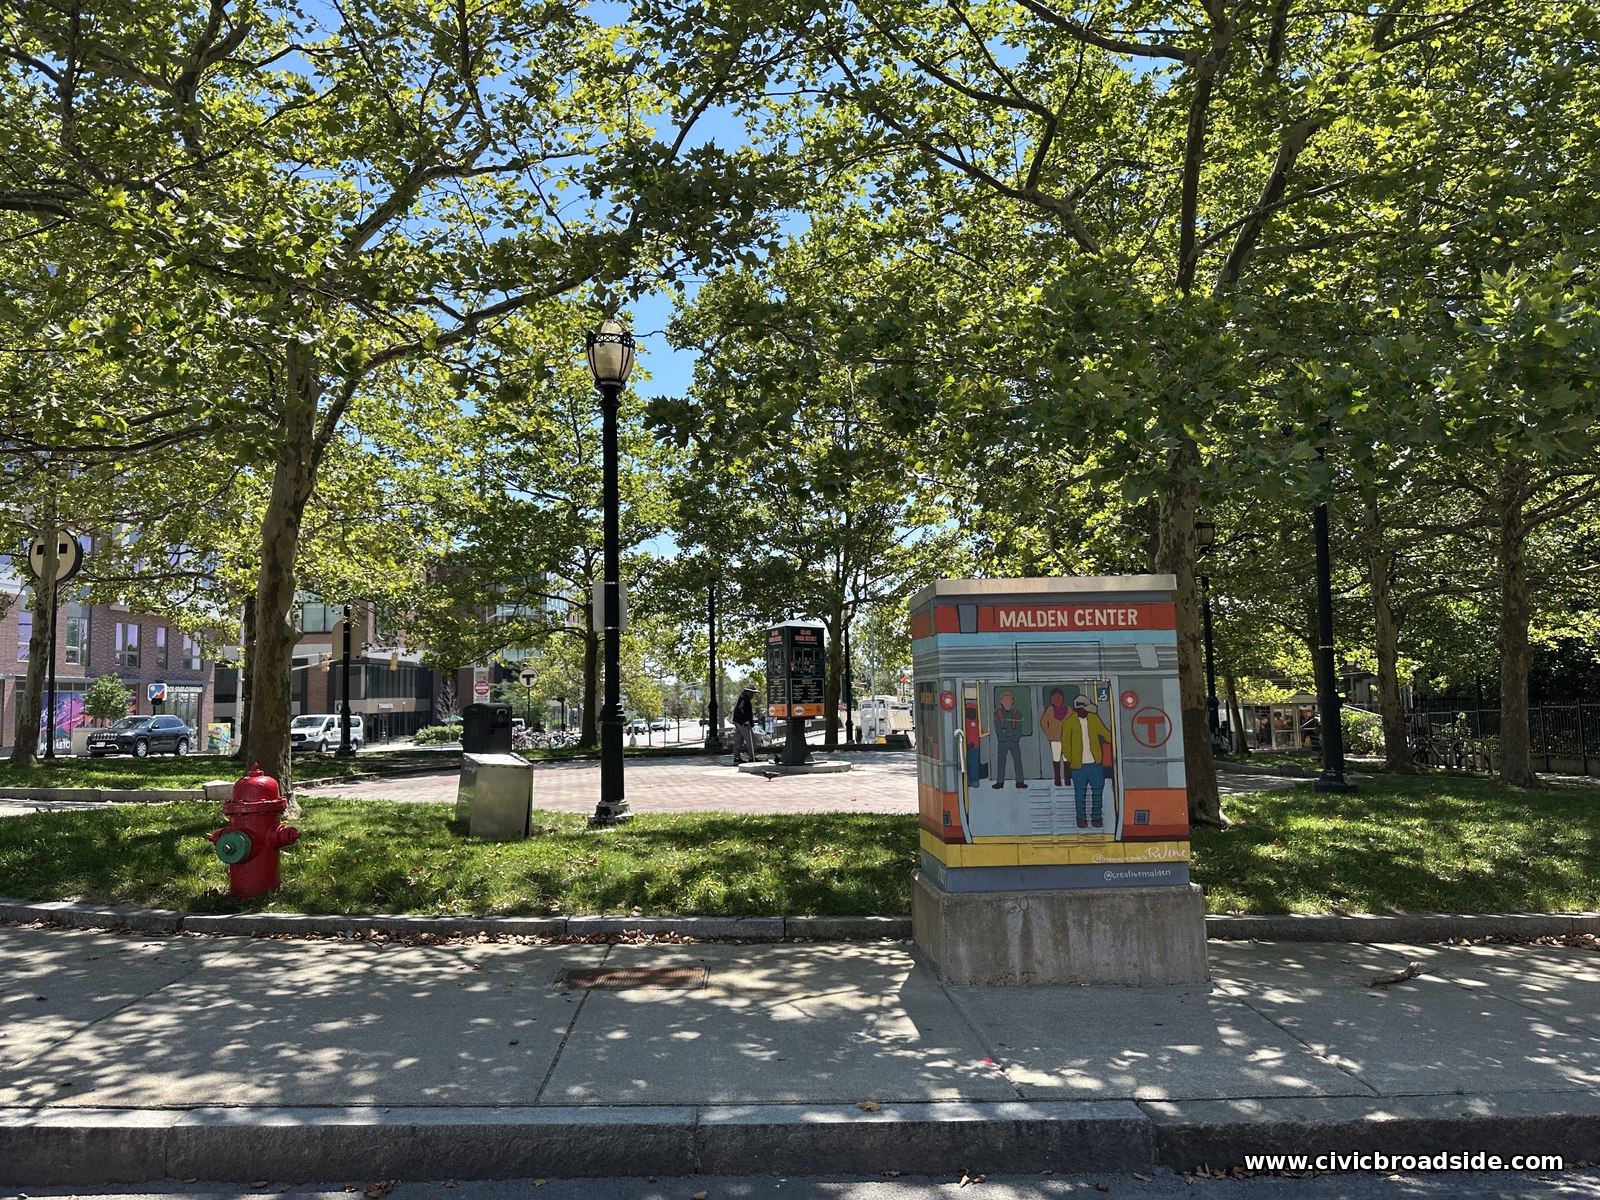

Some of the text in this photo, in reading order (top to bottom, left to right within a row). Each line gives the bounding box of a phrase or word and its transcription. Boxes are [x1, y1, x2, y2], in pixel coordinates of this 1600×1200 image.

[999, 608, 1138, 628] MALDEN CENTER
[522, 674, 535, 686] T
[901, 696, 907, 704] 6
[1136, 715, 1166, 744] T
[1103, 868, 1171, 881] @creativemalden
